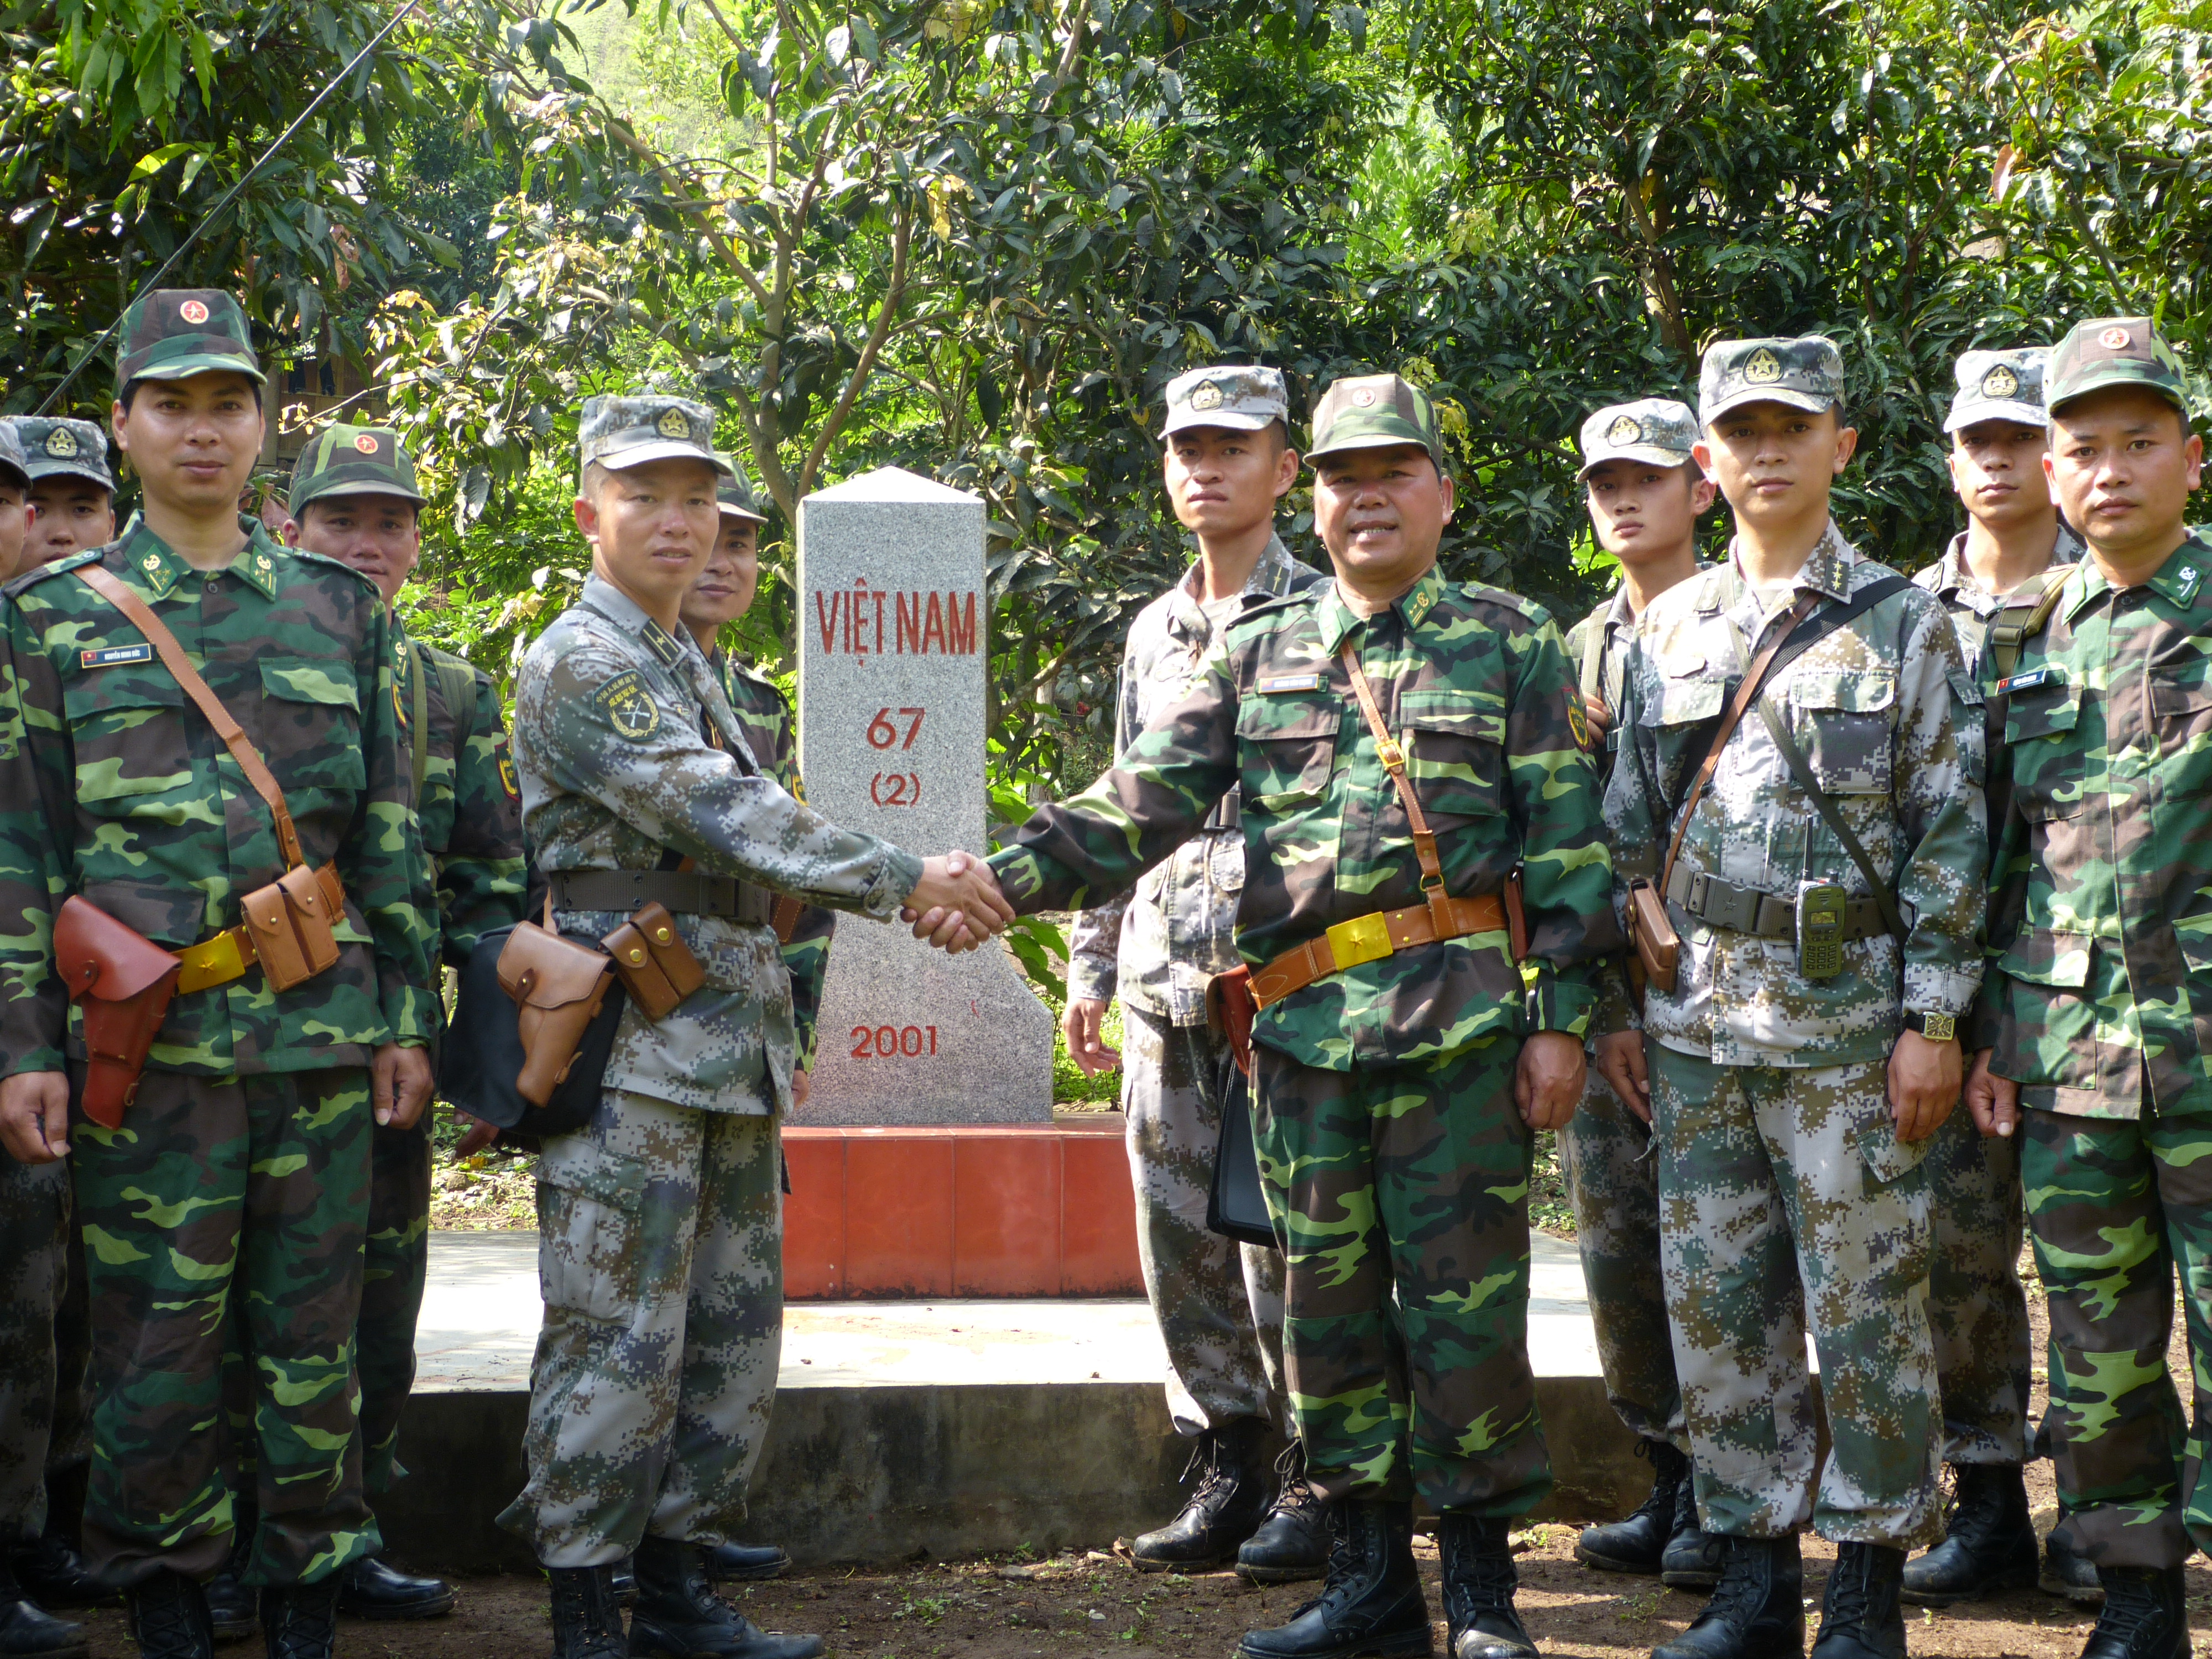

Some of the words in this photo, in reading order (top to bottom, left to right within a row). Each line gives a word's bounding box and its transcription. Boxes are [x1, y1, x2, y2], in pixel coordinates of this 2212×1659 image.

[816, 577, 886, 667] VIỆT
[896, 591, 975, 655] NAM
[608, 685, 637, 707] 成都军区
[866, 707, 925, 750] 67
[870, 771, 921, 808] (2)
[850, 1025, 937, 1058] 2001
